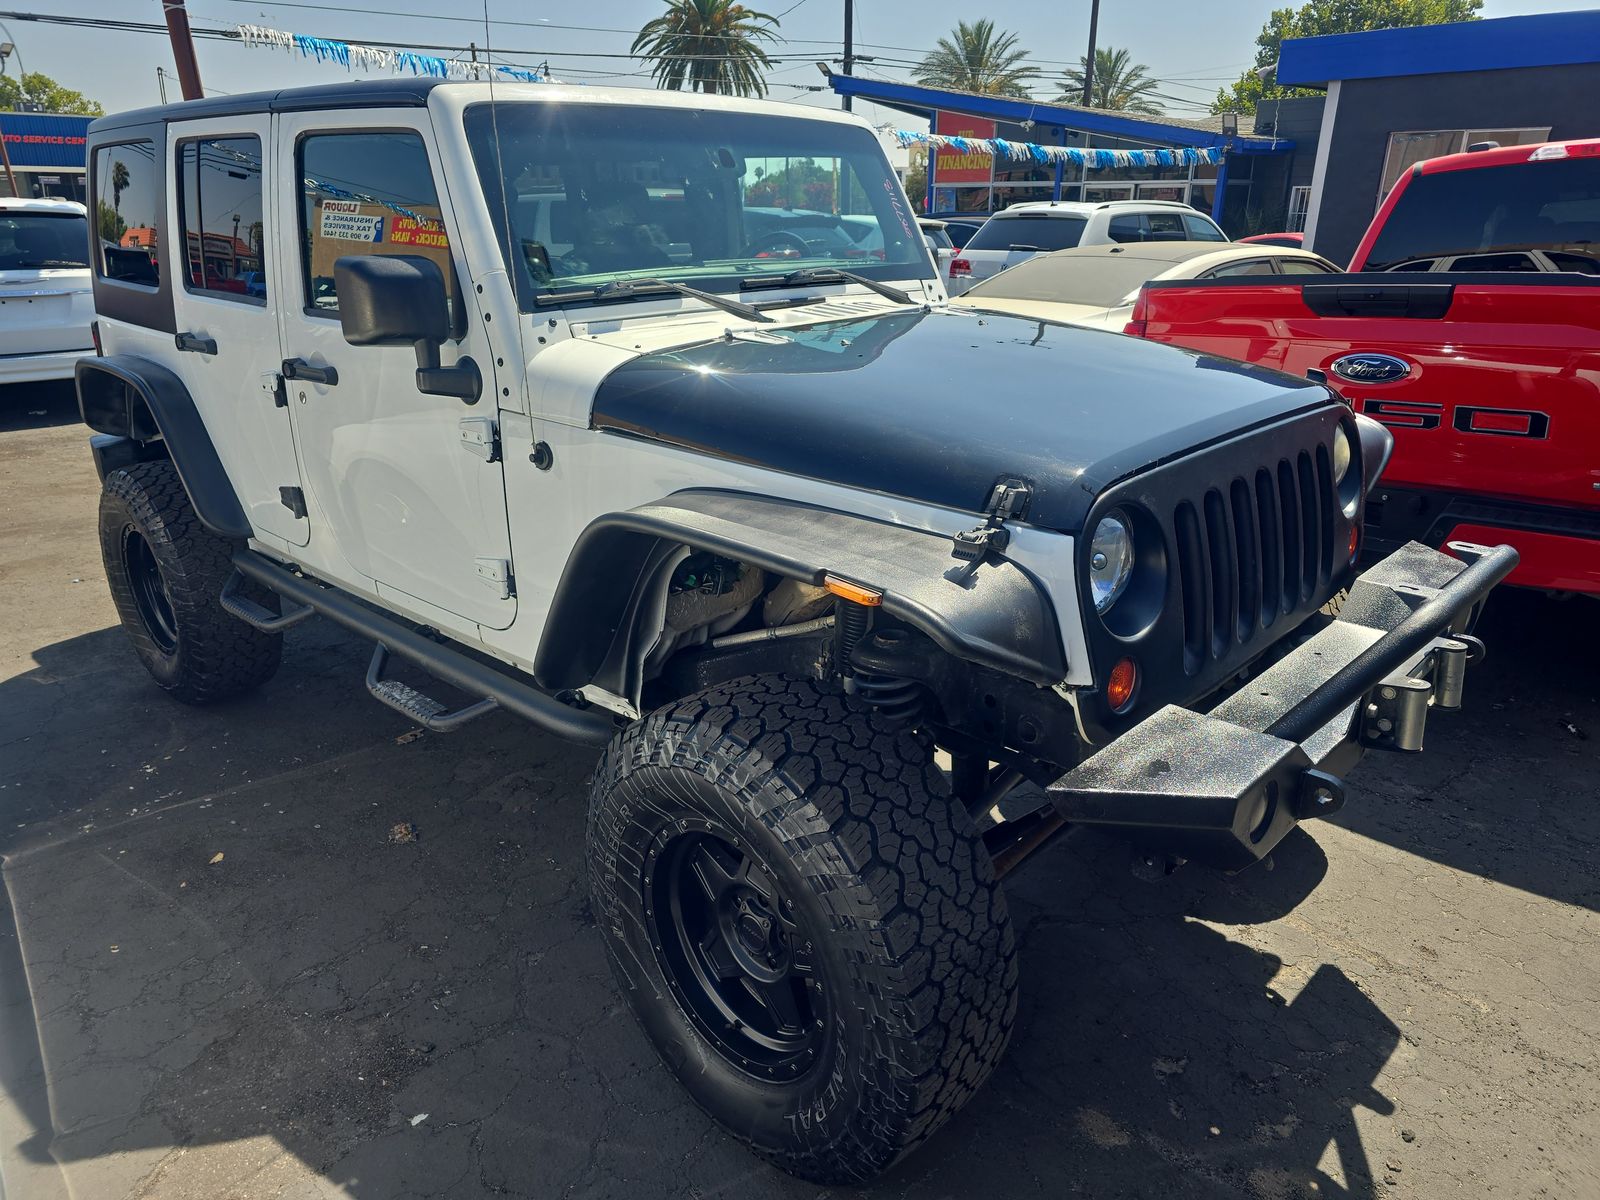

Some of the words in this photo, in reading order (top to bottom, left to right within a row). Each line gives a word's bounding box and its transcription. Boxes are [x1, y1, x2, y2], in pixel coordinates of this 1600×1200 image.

[2, 134, 21, 143] UTO
[23, 135, 64, 144] SERVICE
[937, 153, 992, 170] FINANCING
[1347, 359, 1391, 377] Ford
